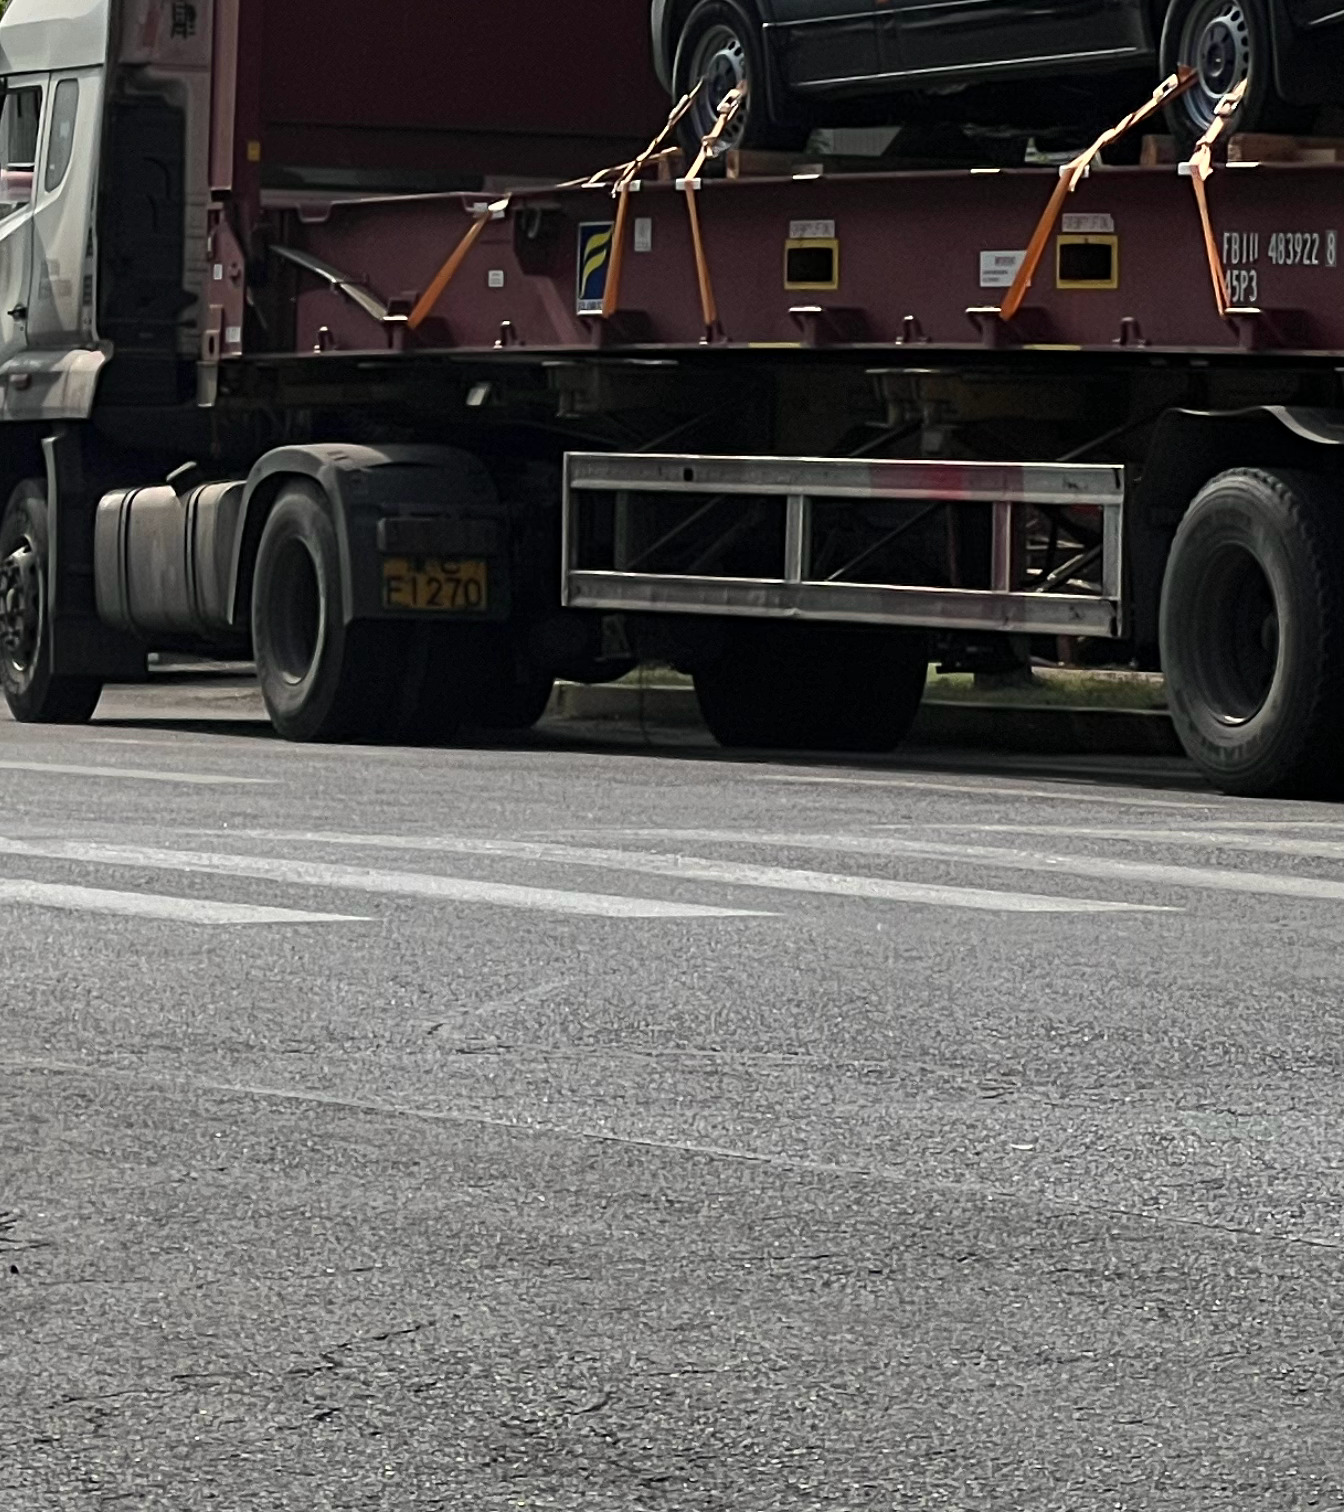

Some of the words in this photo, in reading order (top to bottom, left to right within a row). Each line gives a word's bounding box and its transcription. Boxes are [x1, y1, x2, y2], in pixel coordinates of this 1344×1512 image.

[1223, 232, 1258, 264] FBIU
[1268, 232, 1319, 265] 483922
[1326, 231, 1336, 266] 8
